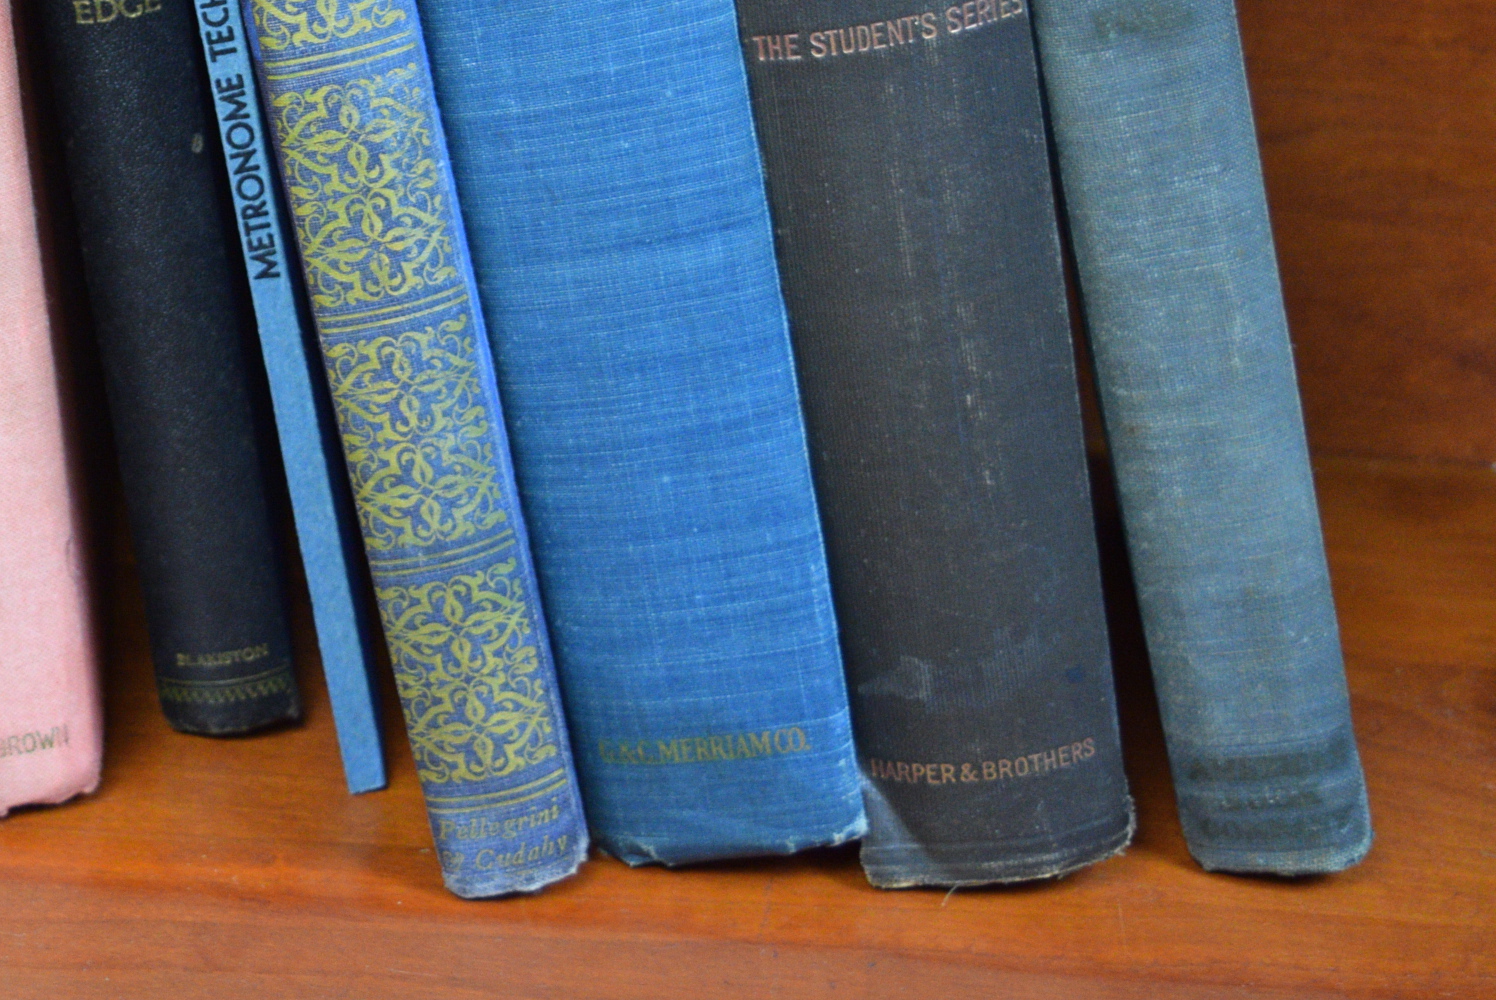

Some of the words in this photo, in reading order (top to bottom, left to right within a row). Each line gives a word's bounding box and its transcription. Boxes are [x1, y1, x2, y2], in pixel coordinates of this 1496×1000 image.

[753, 32, 803, 61] THE
[810, 12, 938, 59] STUDENT'S
[213, 72, 282, 281] METRONOME
[658, 730, 772, 764] MERRIAM
[870, 757, 956, 785] HARPER
[960, 762, 979, 783] &
[982, 737, 1097, 782] BROTHERS
[438, 797, 561, 840] Pellegrini
[475, 835, 569, 871] Cudahy
